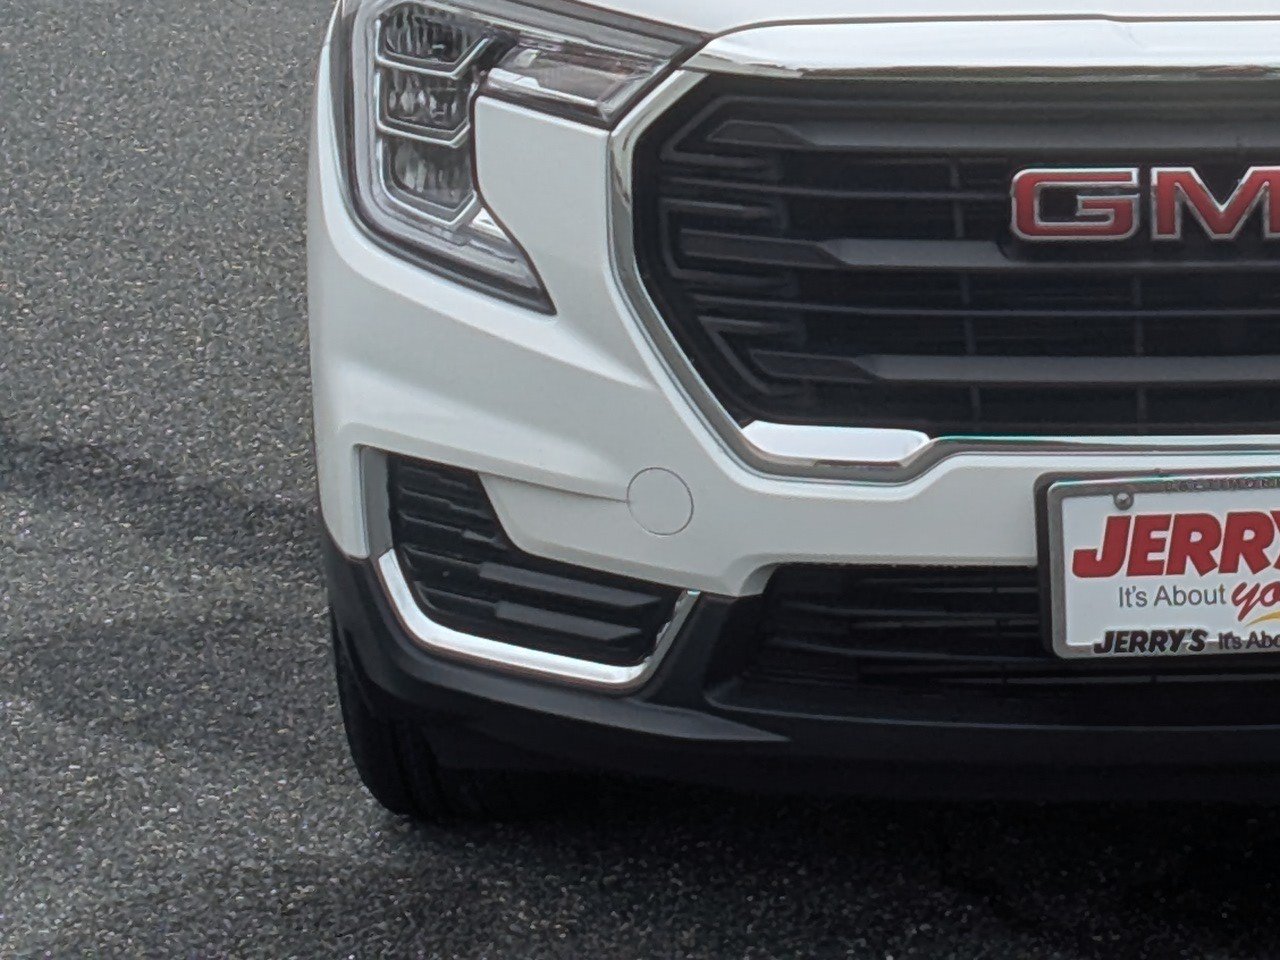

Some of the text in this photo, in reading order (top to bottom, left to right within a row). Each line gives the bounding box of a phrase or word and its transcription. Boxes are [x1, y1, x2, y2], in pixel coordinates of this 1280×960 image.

[1118, 586, 1148, 608] It's
[1153, 583, 1227, 608] About
[1093, 628, 1209, 654] JERRY'S
[1218, 630, 1243, 650] It's
